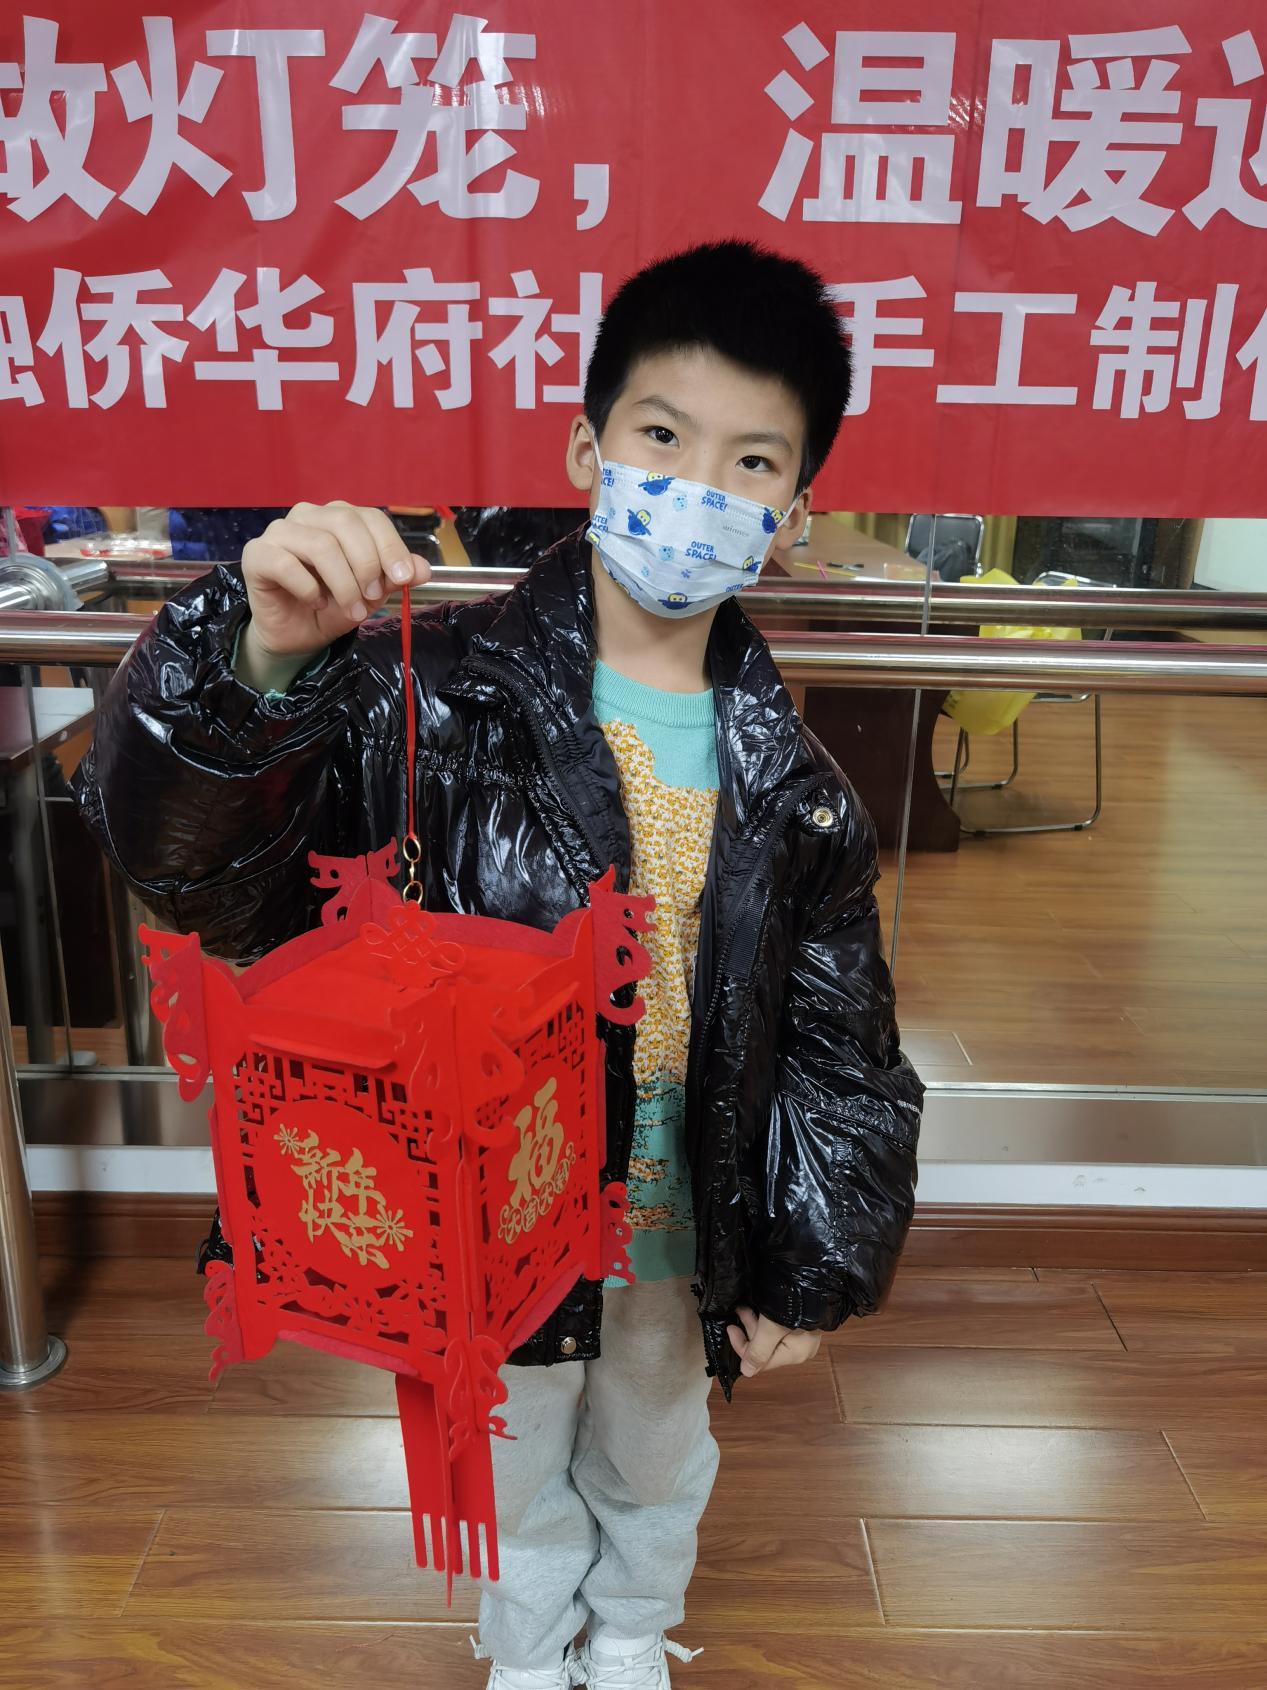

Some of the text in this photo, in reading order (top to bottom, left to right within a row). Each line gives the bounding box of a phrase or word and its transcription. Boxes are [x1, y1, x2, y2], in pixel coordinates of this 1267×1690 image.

[706, 489, 726, 502] OUTER
[701, 496, 728, 512] SPACE!
[691, 540, 714, 553] OUTER
[685, 547, 717, 561] SPACE!
[509, 1076, 565, 1209] 福
